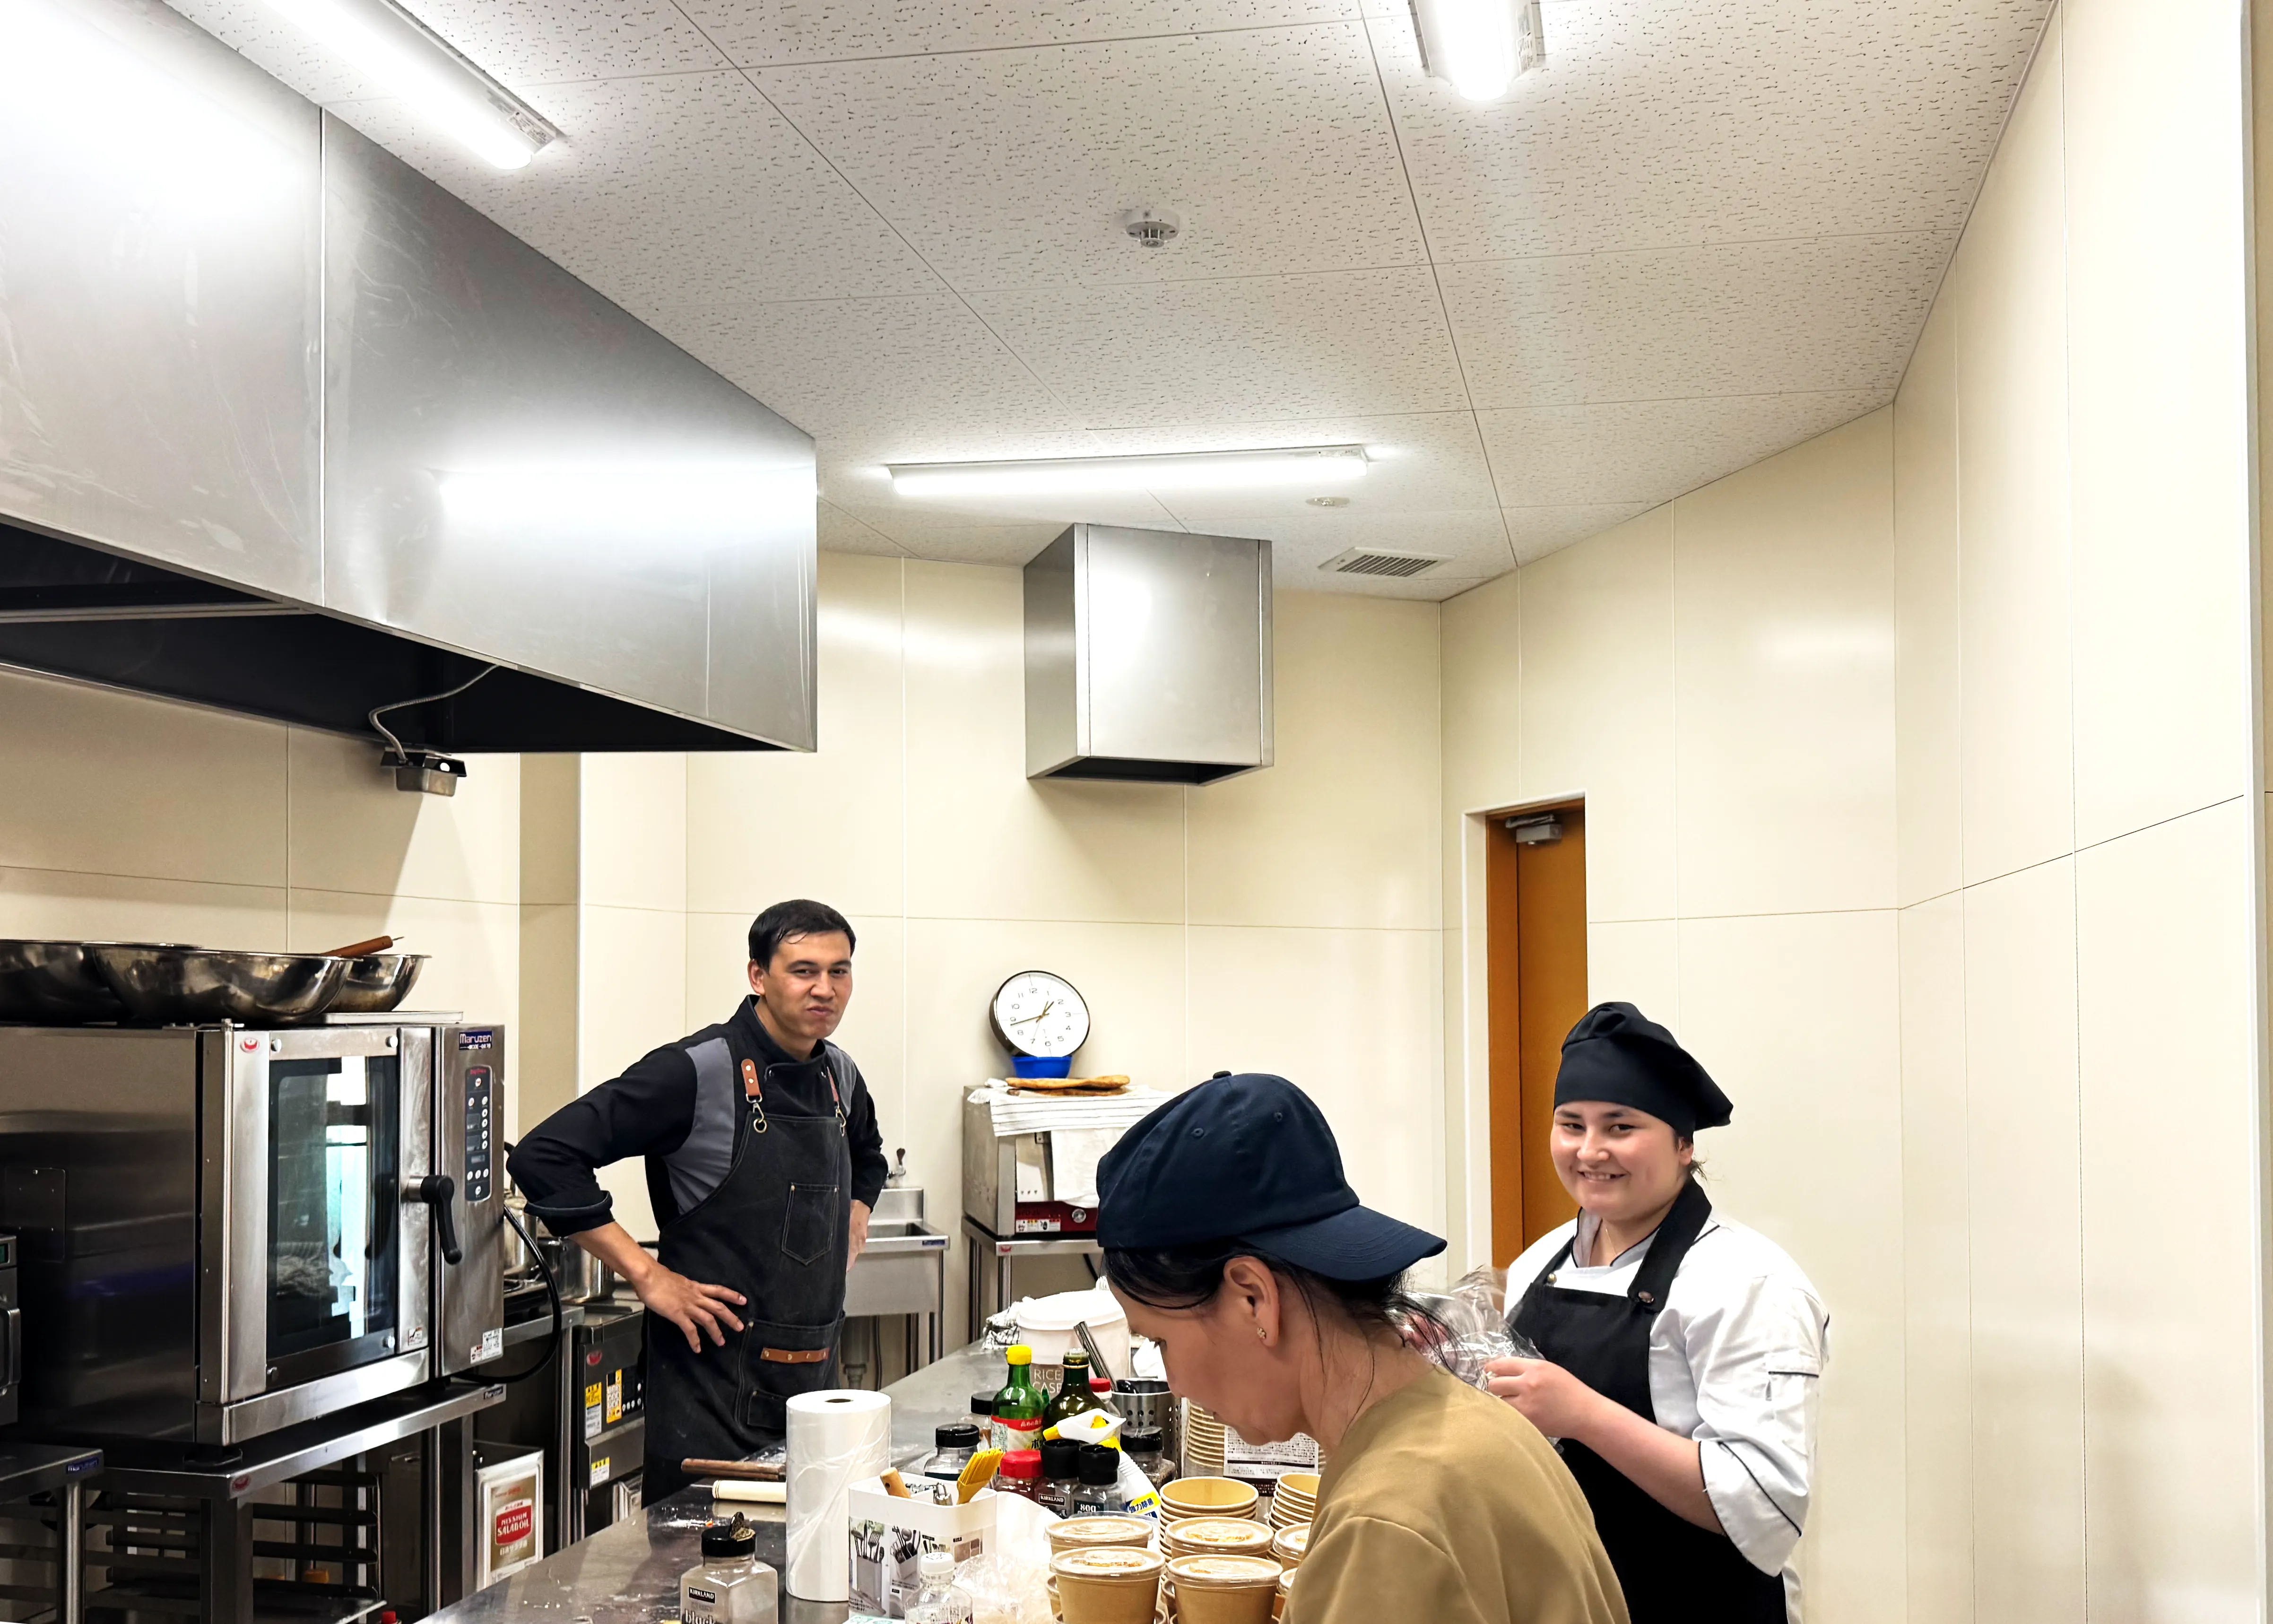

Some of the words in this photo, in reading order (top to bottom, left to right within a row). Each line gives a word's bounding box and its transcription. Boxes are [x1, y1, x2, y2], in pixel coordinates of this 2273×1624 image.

[460, 1033, 492, 1044] Maruzen
[1034, 1369, 1062, 1381] RICE
[690, 1588, 714, 1599] KIRKLAND
